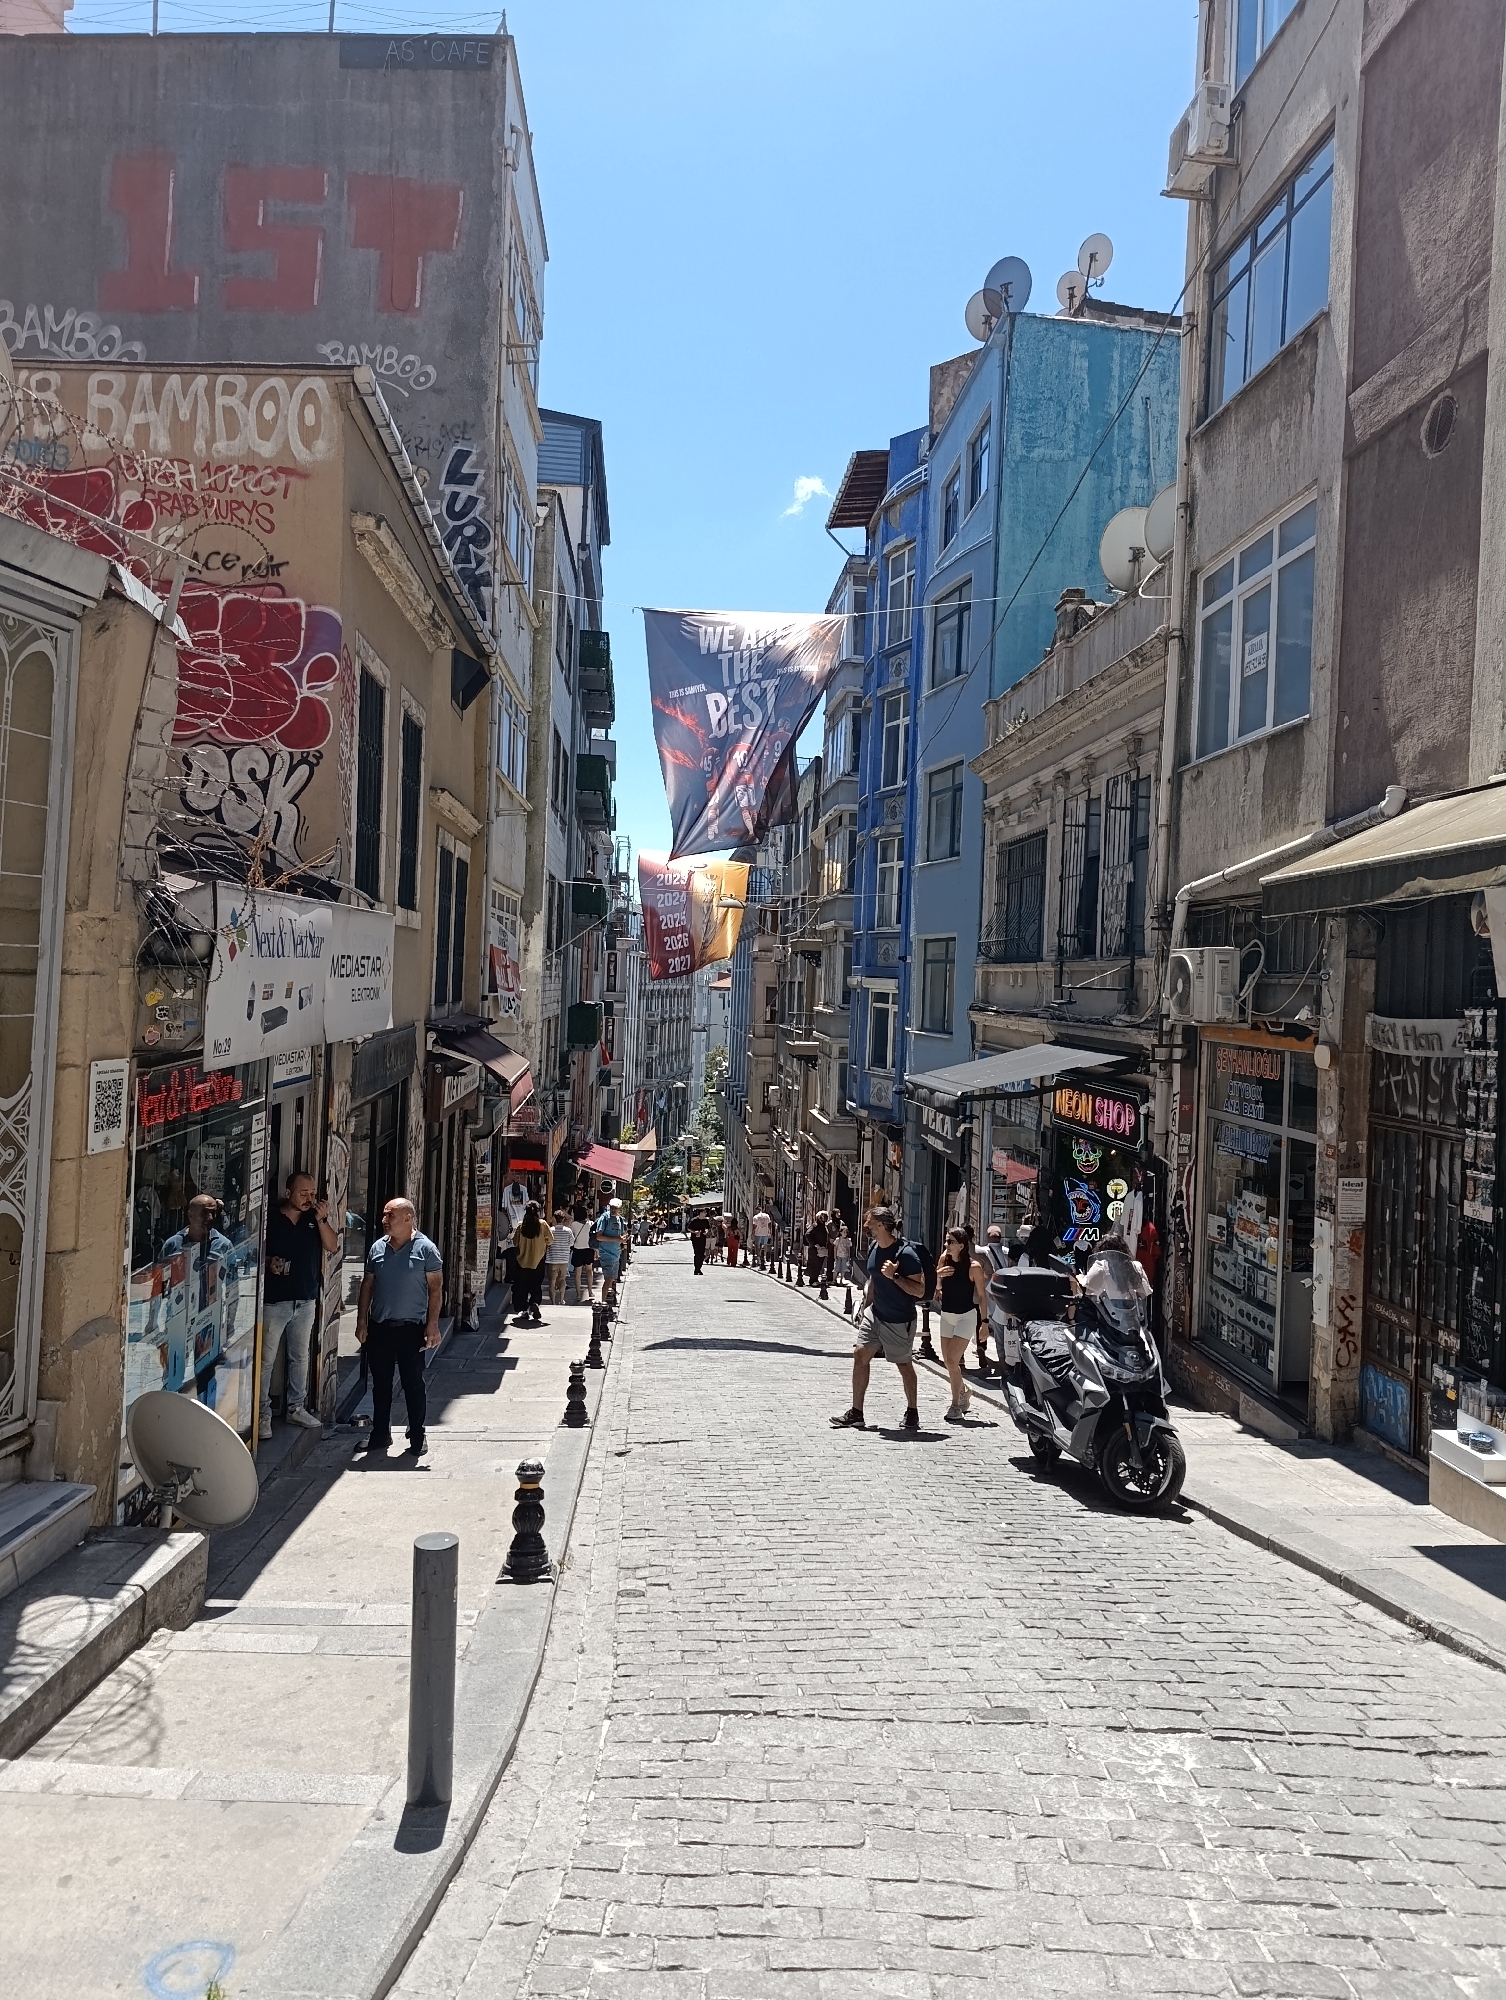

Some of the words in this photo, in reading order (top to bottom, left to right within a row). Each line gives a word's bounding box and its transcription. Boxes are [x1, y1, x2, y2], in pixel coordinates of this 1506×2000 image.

[699, 626, 737, 655] WE
[718, 648, 763, 688] THE
[705, 678, 780, 740] BEST
[656, 891, 687, 908] 2024
[251, 918, 276, 959] Next
[663, 932, 690, 951] 2026
[668, 954, 691, 974] 2027
[1055, 1088, 1093, 1125] NEON
[1095, 1096, 1136, 1136] SHOP
[1223, 1098, 1241, 1114] ANA
